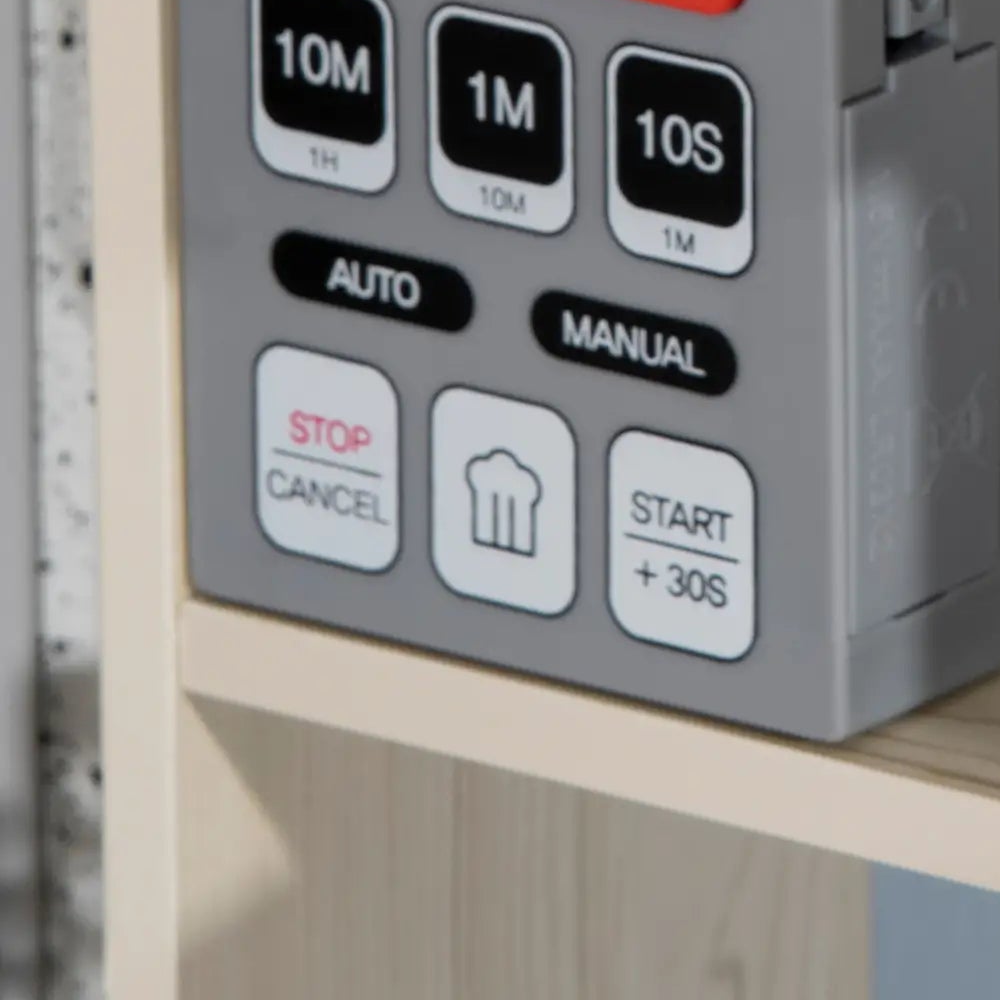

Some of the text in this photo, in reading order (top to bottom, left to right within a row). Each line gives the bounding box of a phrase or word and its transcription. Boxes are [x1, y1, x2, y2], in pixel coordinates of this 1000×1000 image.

[274, 28, 371, 95] 10M
[467, 70, 535, 131] 1M
[308, 146, 339, 172] 1H
[635, 108, 724, 174] 10S
[479, 184, 526, 215] 10M
[662, 226, 696, 254] 1M
[327, 257, 421, 308] AUTO
[561, 310, 706, 377] MANUAL
[288, 409, 372, 454] STOP
[265, 468, 391, 526] CANCEL
[630, 490, 733, 543] START
